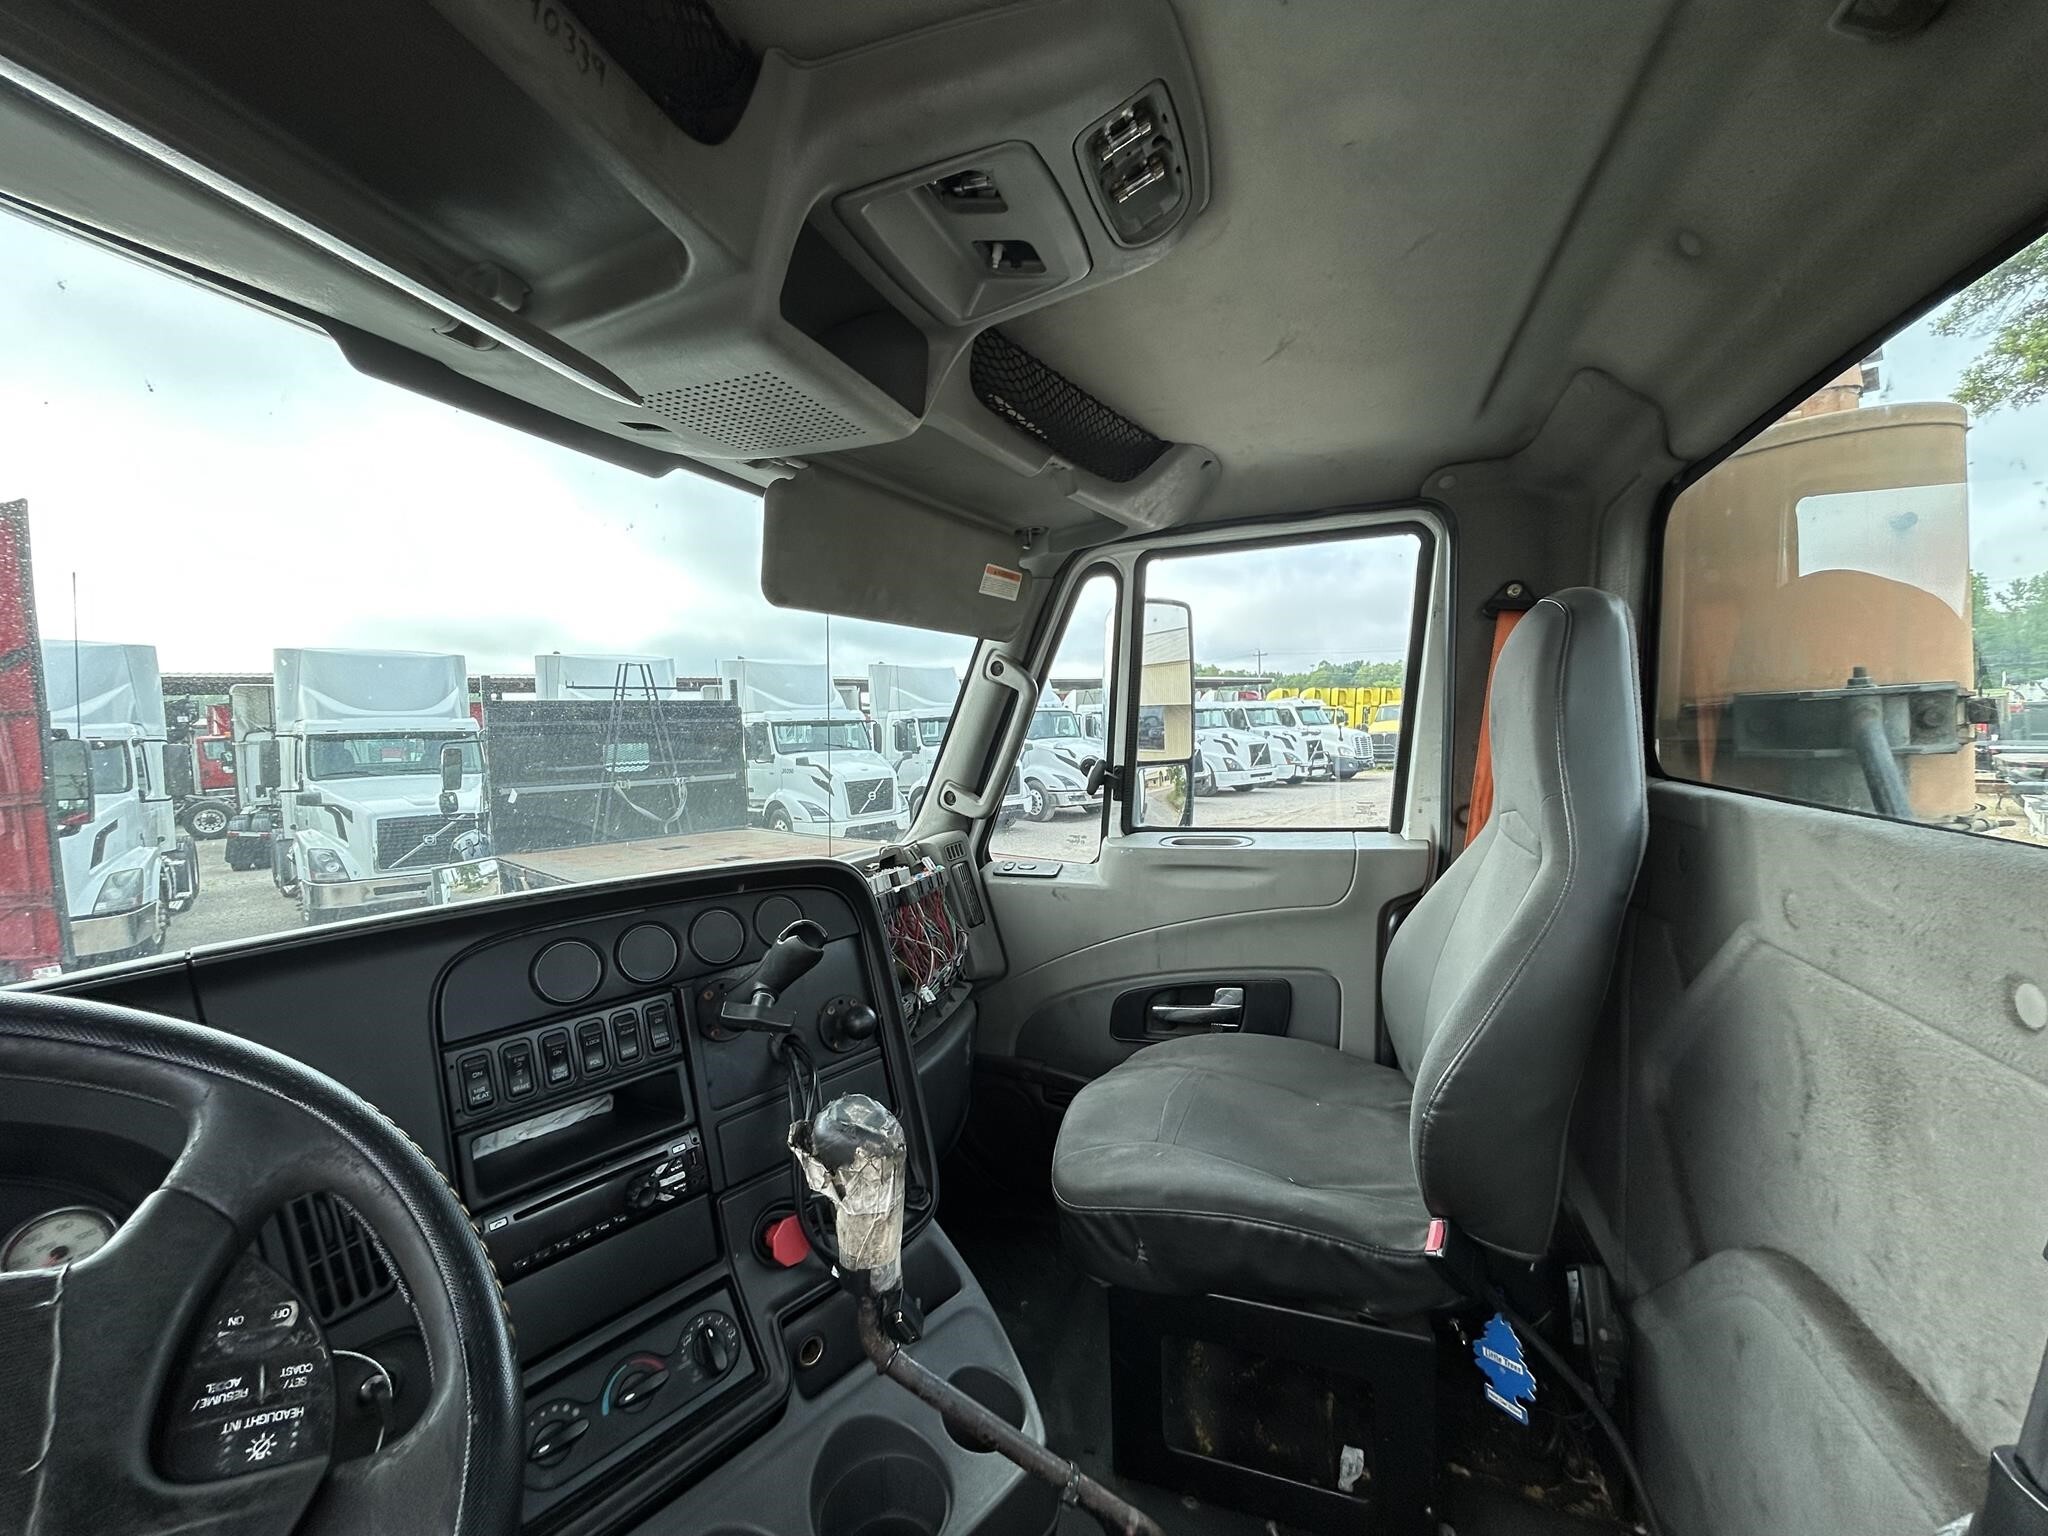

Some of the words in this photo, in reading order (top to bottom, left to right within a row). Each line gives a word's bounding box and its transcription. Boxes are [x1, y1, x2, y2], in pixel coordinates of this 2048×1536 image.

[227, 1314, 245, 1327] ON
[270, 1307, 291, 1321] OFF
[279, 1362, 314, 1378] COAST
[244, 1407, 304, 1428] HEADLIGHT
[220, 1419, 243, 1435] INT
